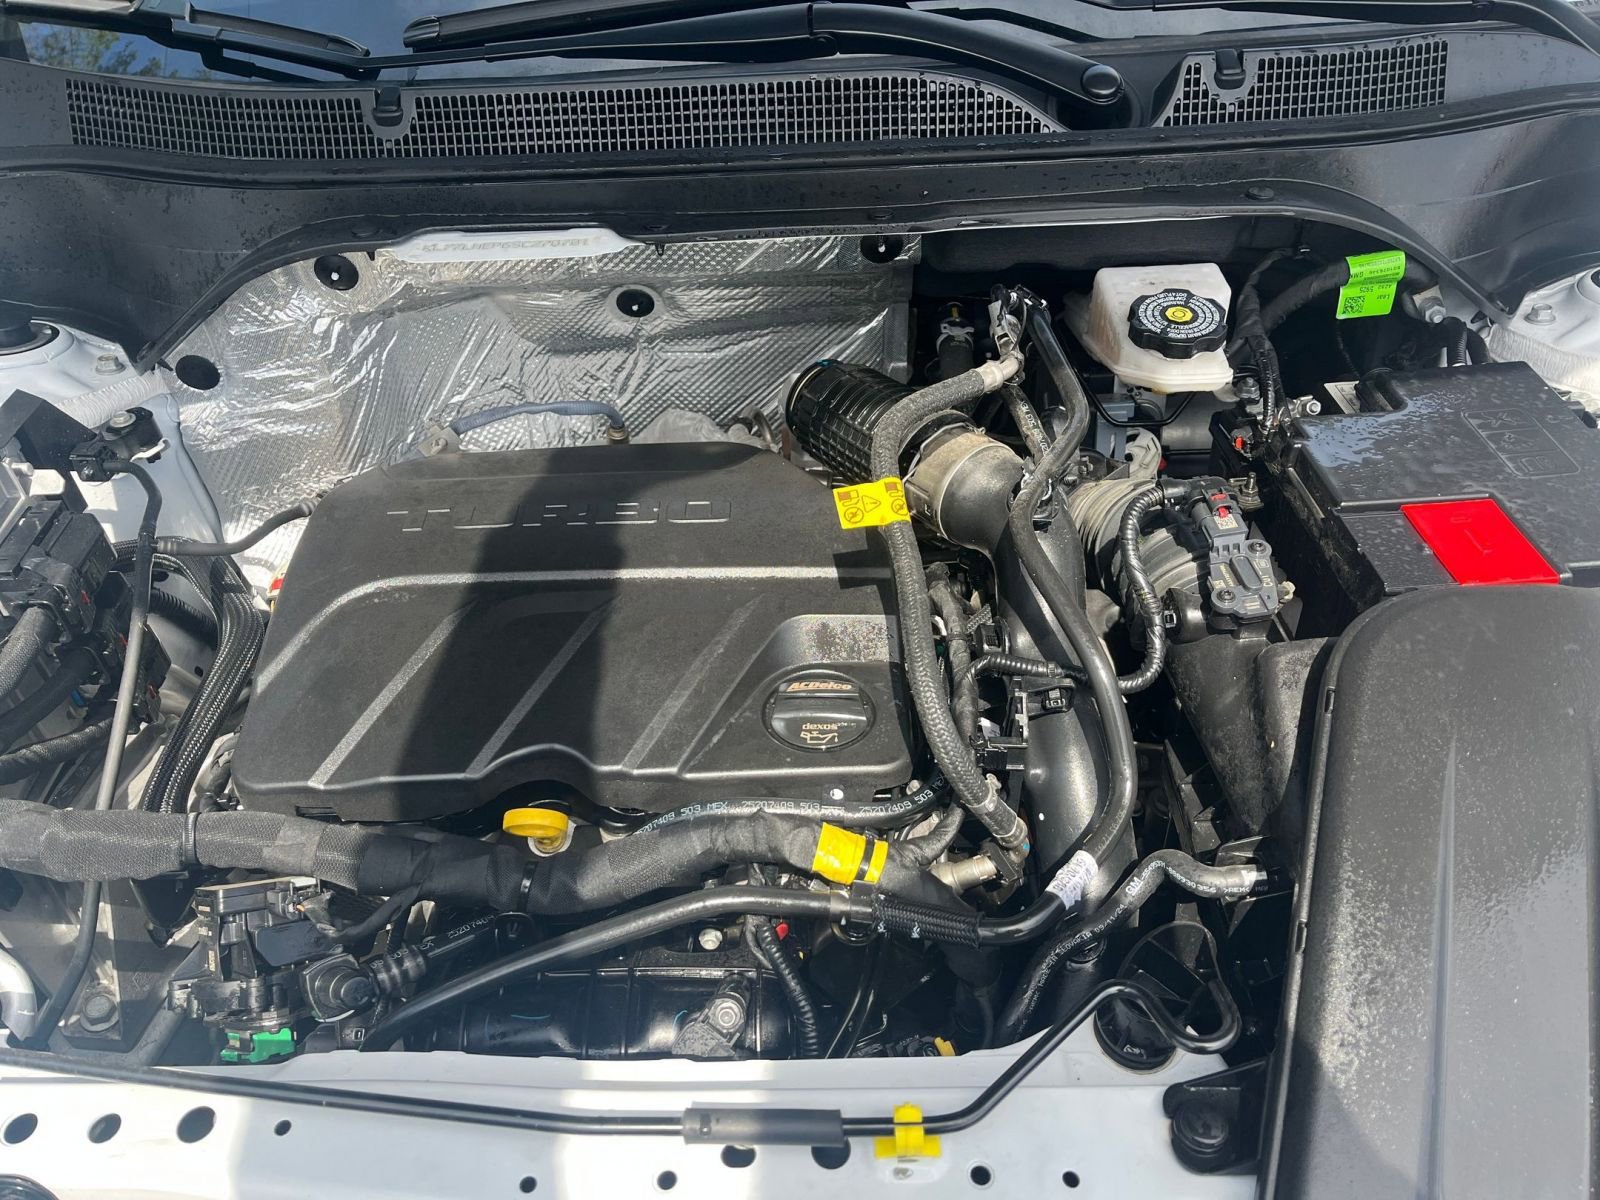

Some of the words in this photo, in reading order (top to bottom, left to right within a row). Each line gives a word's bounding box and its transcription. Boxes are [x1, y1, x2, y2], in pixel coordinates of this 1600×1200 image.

[386, 500, 732, 532] TURBO
[786, 681, 852, 692] ACDelco
[680, 804, 701, 817] 503
[706, 801, 729, 813] MEX
[741, 801, 795, 812] 25207409
[800, 802, 820, 812] 503
[913, 789, 934, 804] 503
